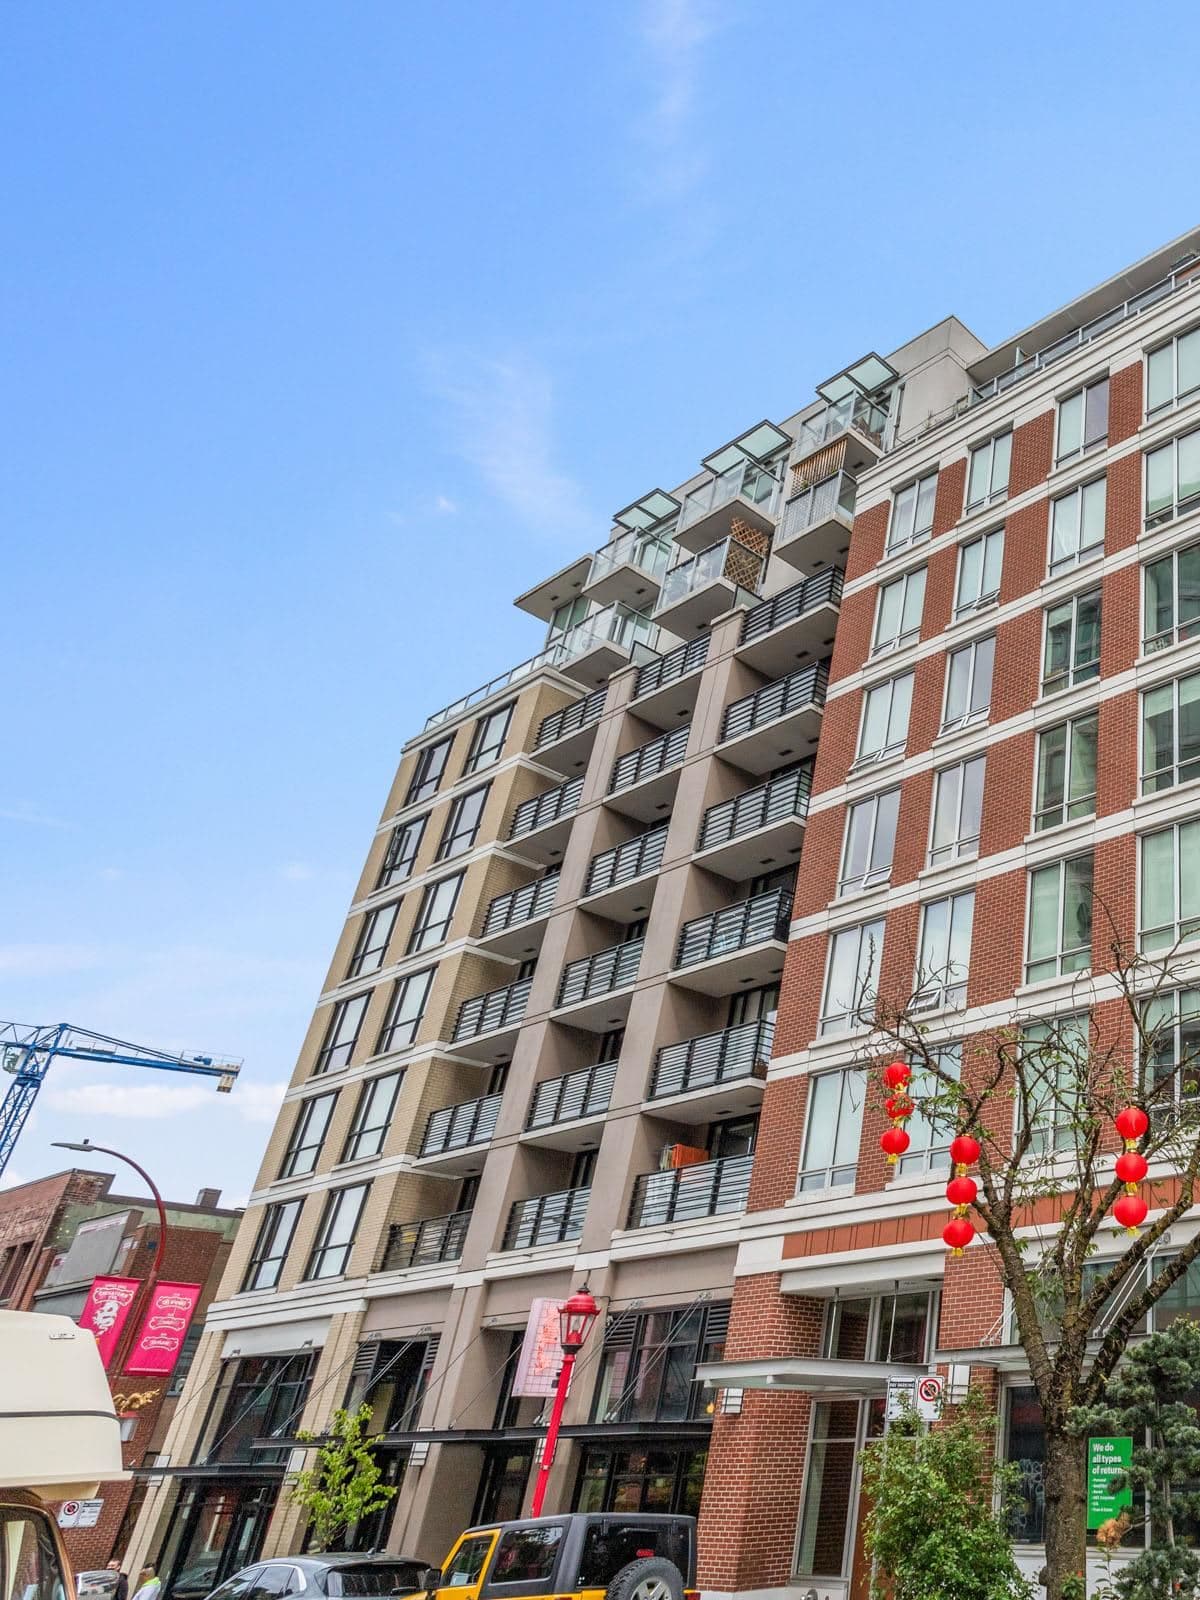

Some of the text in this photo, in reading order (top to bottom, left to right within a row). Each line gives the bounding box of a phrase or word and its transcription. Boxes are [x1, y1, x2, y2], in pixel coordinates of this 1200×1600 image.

[1093, 1442, 1114, 1452] We do
[1092, 1455, 1122, 1464] all types
[1092, 1466, 1126, 1475] of return
